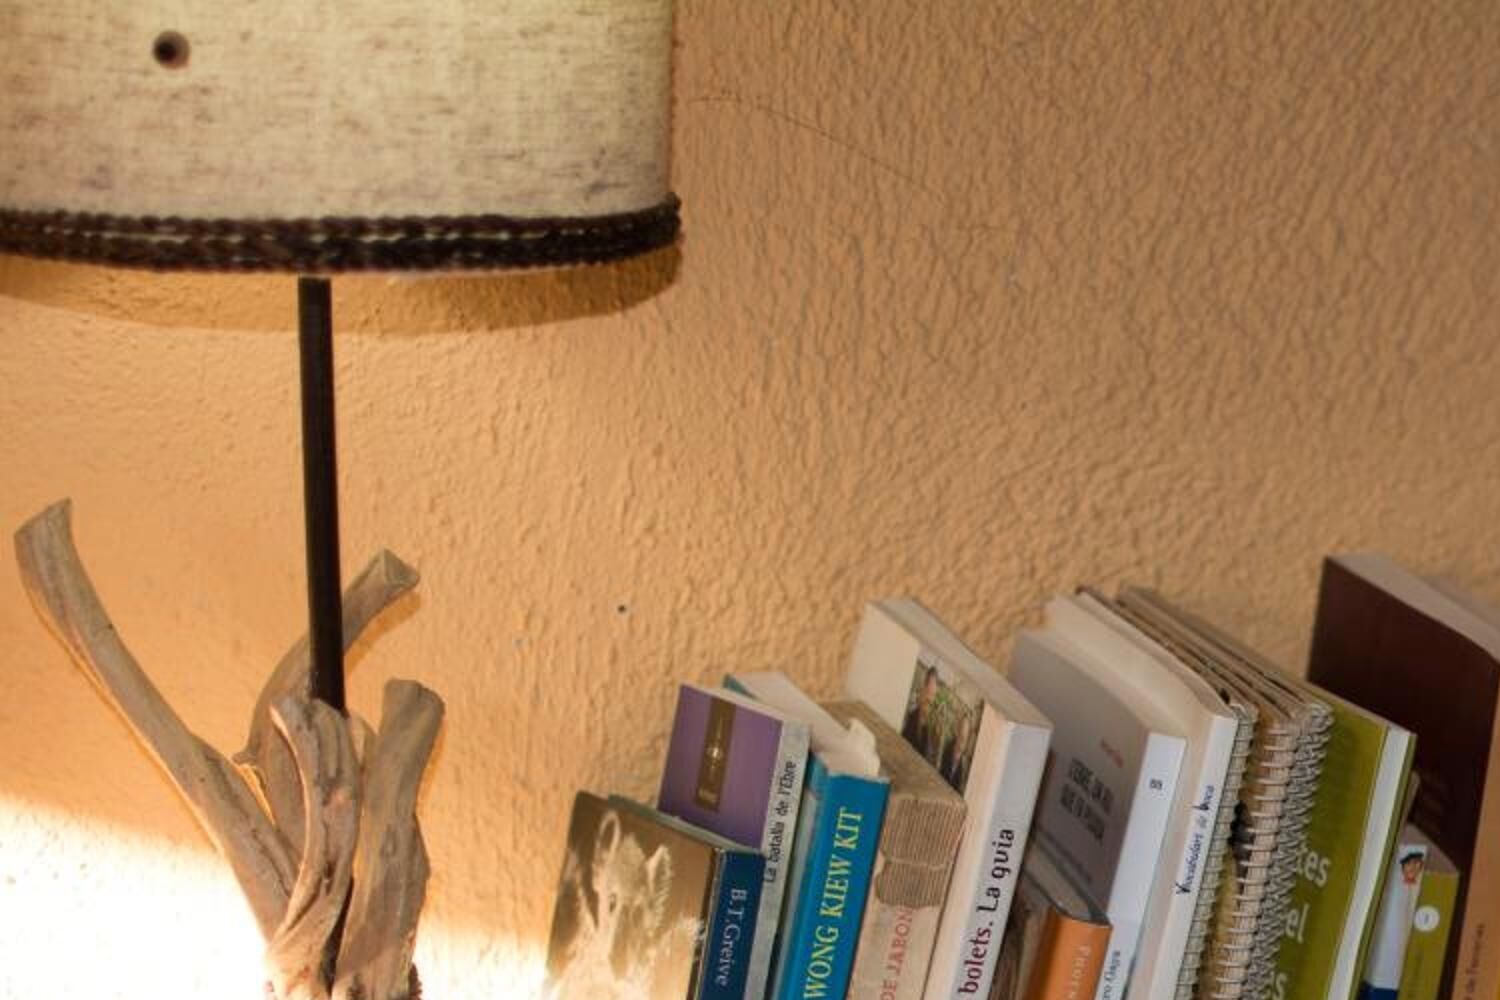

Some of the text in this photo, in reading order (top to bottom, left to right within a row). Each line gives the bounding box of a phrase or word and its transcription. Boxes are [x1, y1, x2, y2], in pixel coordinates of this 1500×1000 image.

[763, 760, 797, 884] La batalla de l'Ebre
[804, 807, 864, 1000] WONG KIEW KIT
[957, 922, 994, 995] bolets.
[976, 886, 1000, 913] La
[991, 828, 1015, 877] guia
